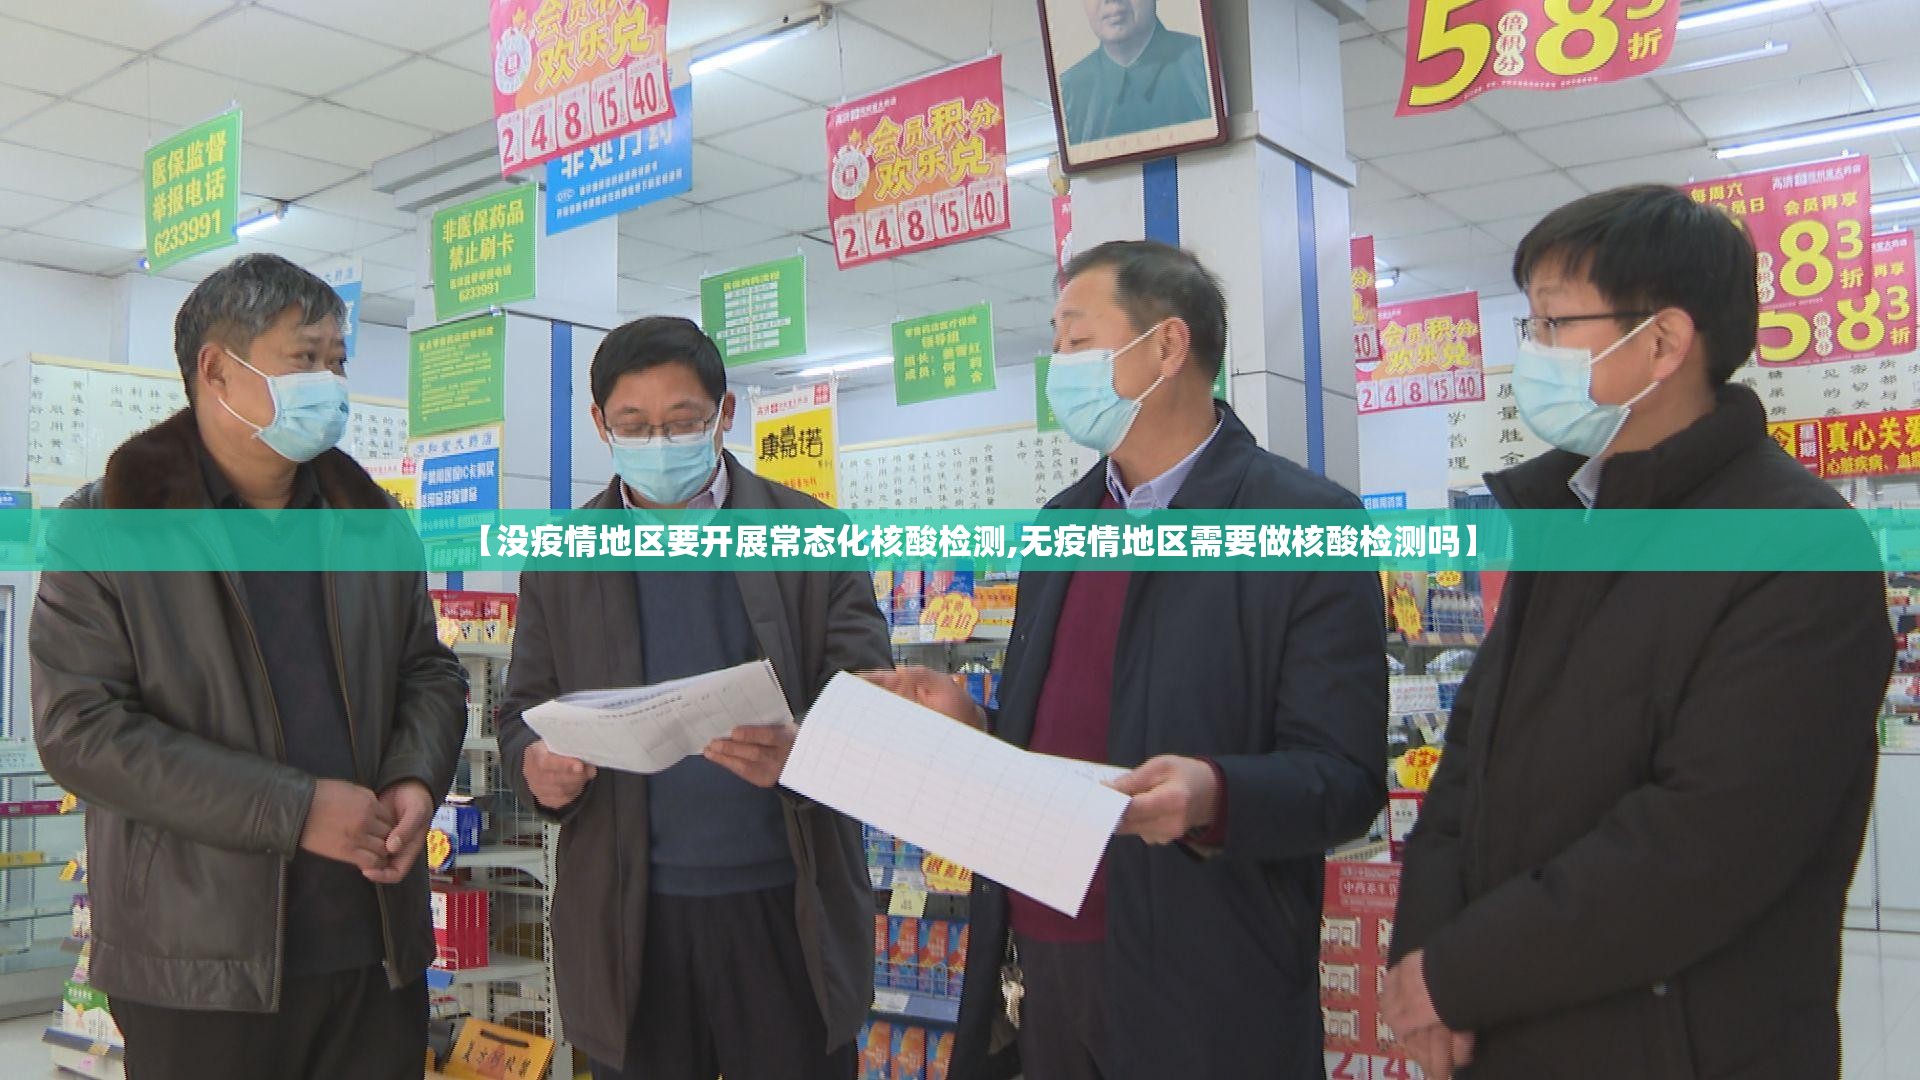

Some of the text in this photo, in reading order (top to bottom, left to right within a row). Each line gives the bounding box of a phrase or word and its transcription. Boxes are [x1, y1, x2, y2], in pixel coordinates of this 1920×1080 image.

[1408, 0, 1491, 106] 5
[1626, 26, 1664, 62] 折
[502, 72, 657, 164] 2 4 8 15 40
[869, 98, 1000, 160] 会员积分
[152, 129, 227, 189] 医保监督
[875, 135, 991, 200] 欢乐兑
[152, 168, 226, 224] 举报电话
[1784, 191, 1858, 216] 会员再享
[153, 209, 222, 257] 6233991
[443, 199, 524, 244] 非医保药品
[843, 191, 995, 258] 2 4 8 15 40
[1836, 219, 1864, 260] 3
[449, 231, 514, 272] 禁止刷卡
[1779, 220, 1833, 296] 8
[1840, 267, 1864, 289] 折
[1886, 285, 1910, 321] 3
[1381, 317, 1478, 348] 会员积分
[1889, 326, 1911, 346] 折
[1386, 342, 1472, 374] 欢乐兑
[1361, 376, 1475, 408] 2 4 8 15 40
